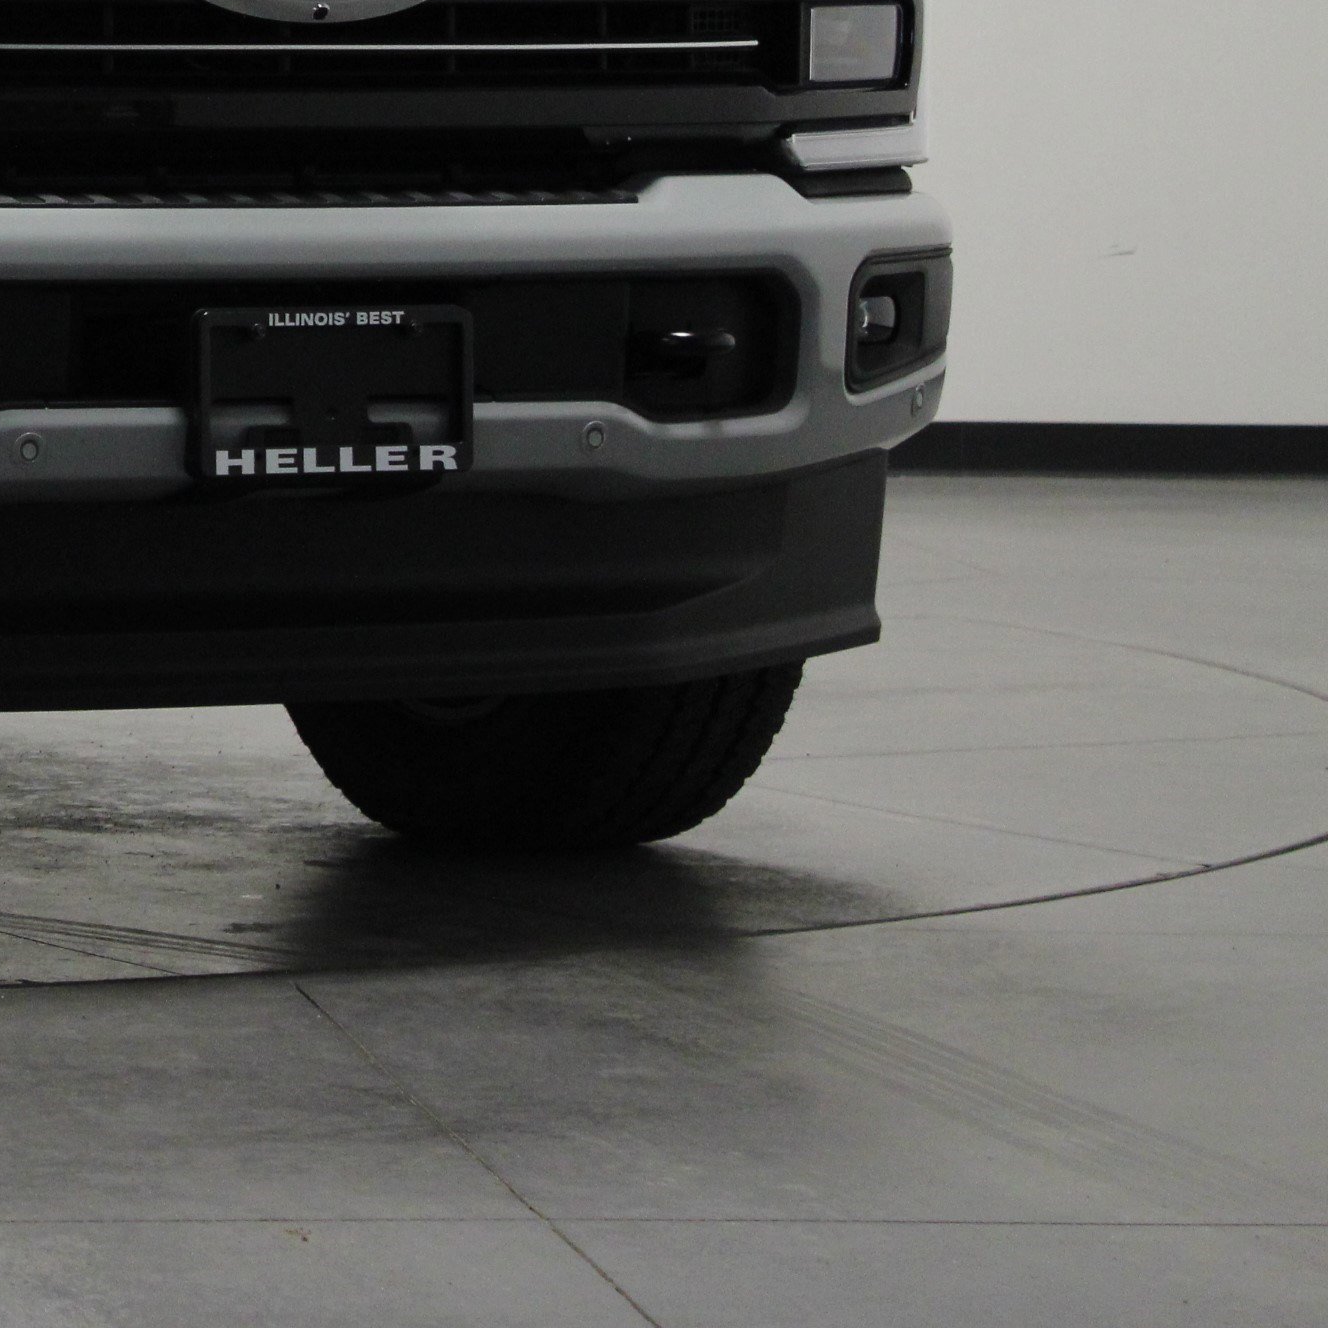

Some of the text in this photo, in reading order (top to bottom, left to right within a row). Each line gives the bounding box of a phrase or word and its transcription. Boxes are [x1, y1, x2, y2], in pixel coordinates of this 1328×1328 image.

[268, 310, 405, 327] ILLINOIS' BEST
[215, 444, 458, 475] HELLER
